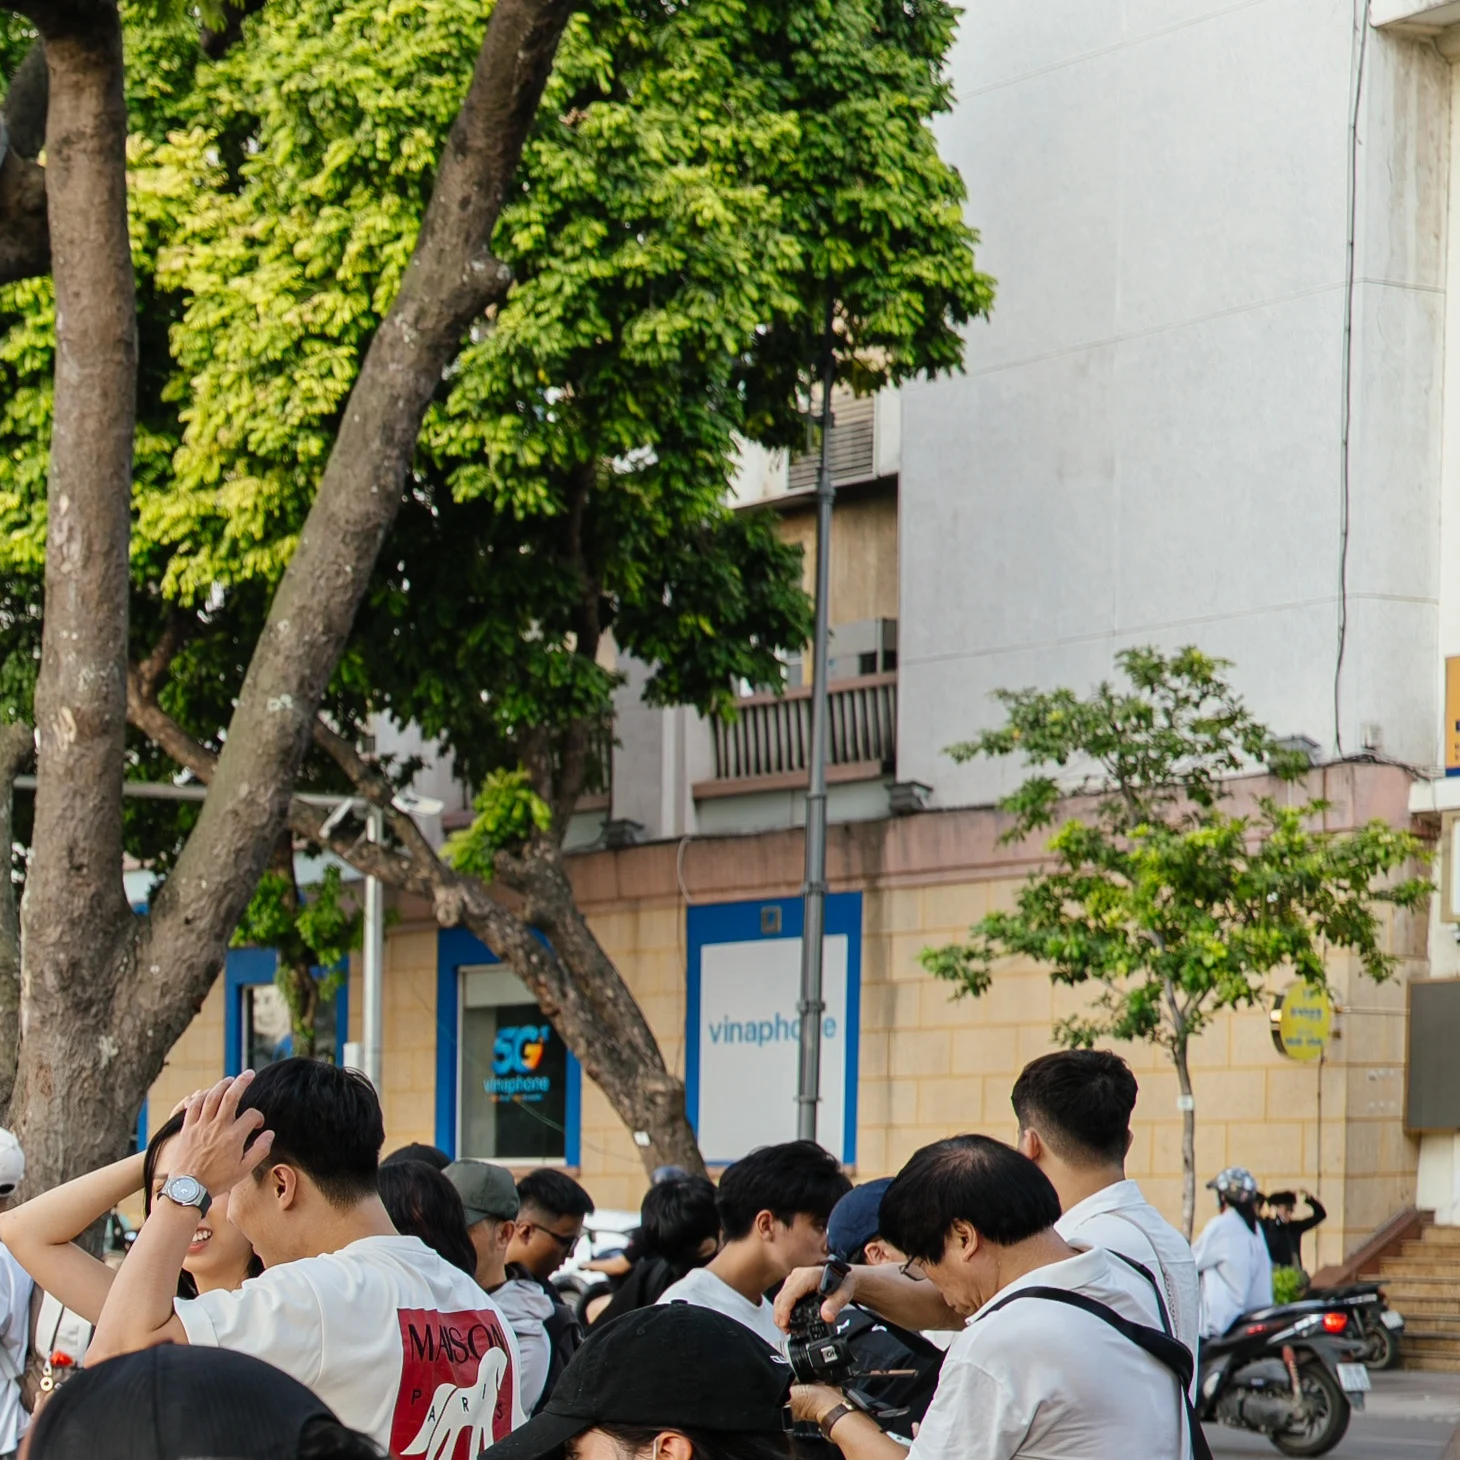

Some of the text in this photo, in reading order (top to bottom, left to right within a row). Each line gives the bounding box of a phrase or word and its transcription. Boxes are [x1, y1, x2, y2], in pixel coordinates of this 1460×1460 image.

[708, 1012, 837, 1047] vinaphoe
[491, 1024, 548, 1075] 5G
[408, 1323, 506, 1363] MAISON
[411, 1383, 504, 1420] PARIS
